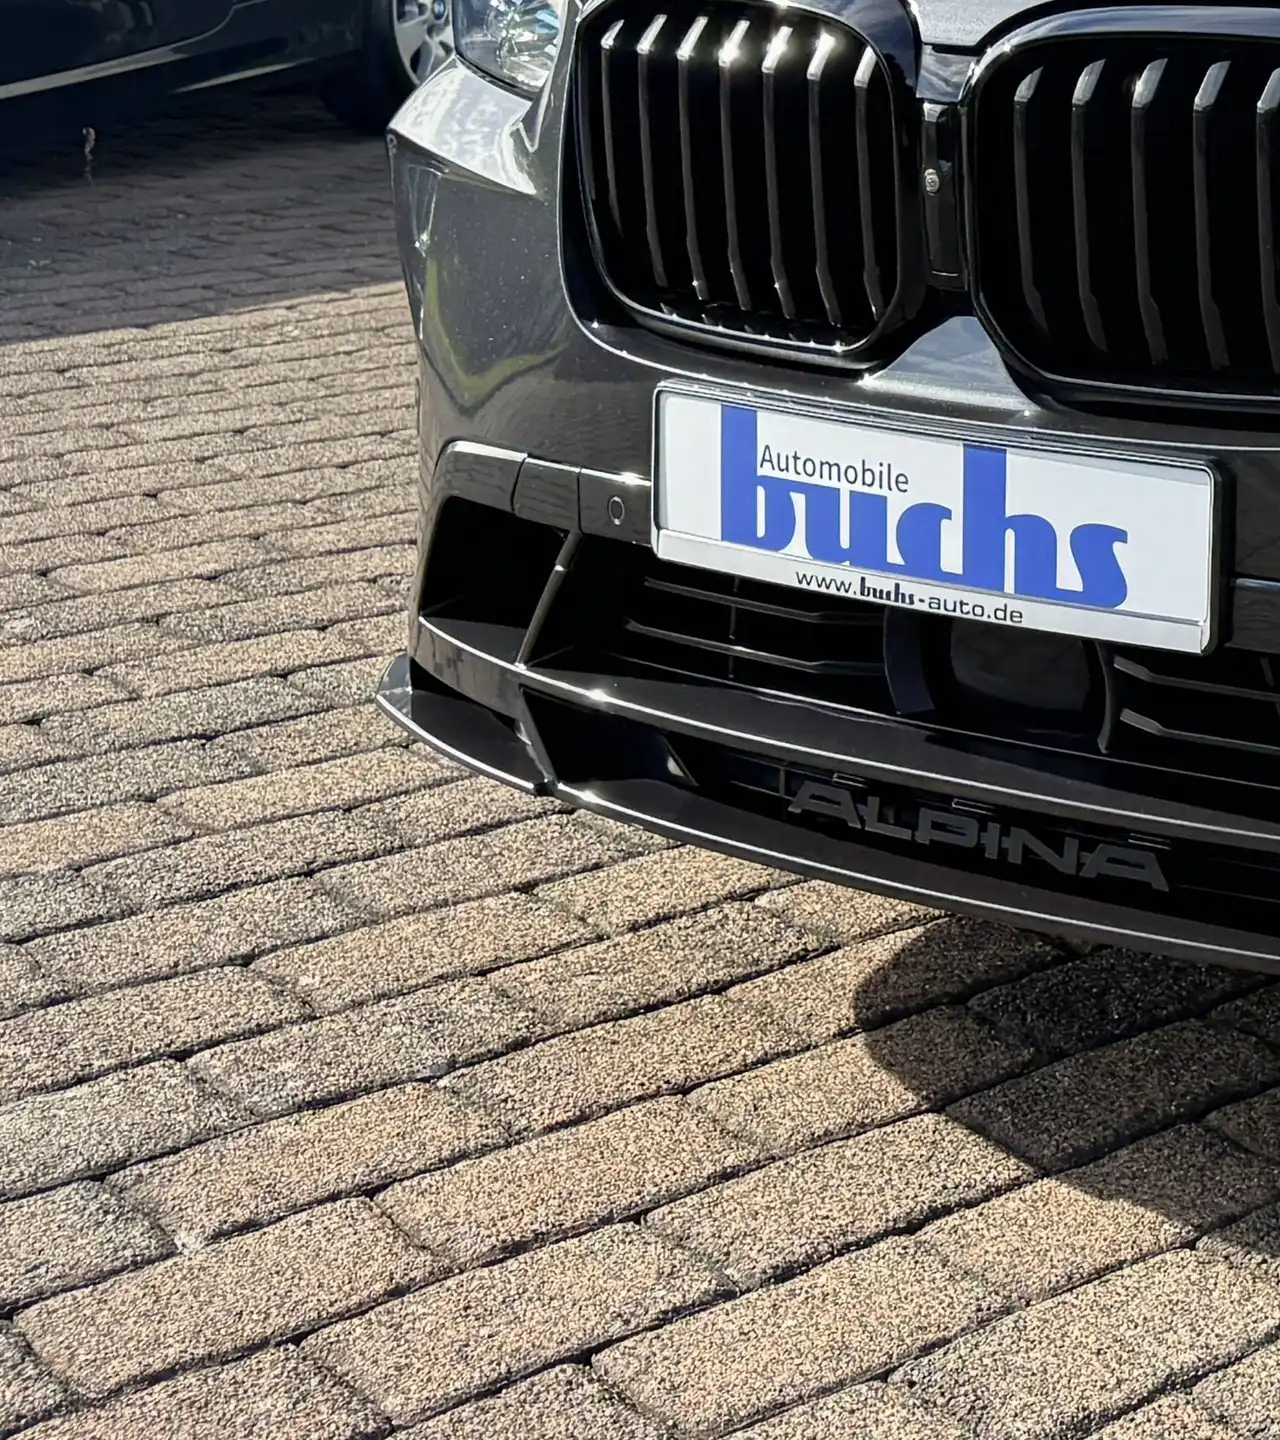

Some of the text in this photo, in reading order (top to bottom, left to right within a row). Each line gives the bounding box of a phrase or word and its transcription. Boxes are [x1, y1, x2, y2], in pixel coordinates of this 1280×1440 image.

[721, 403, 1129, 610] buchs
[759, 443, 910, 494] Automobile
[795, 571, 1024, 624] www.buchs-auto.de
[786, 779, 1170, 893] ALPINA
